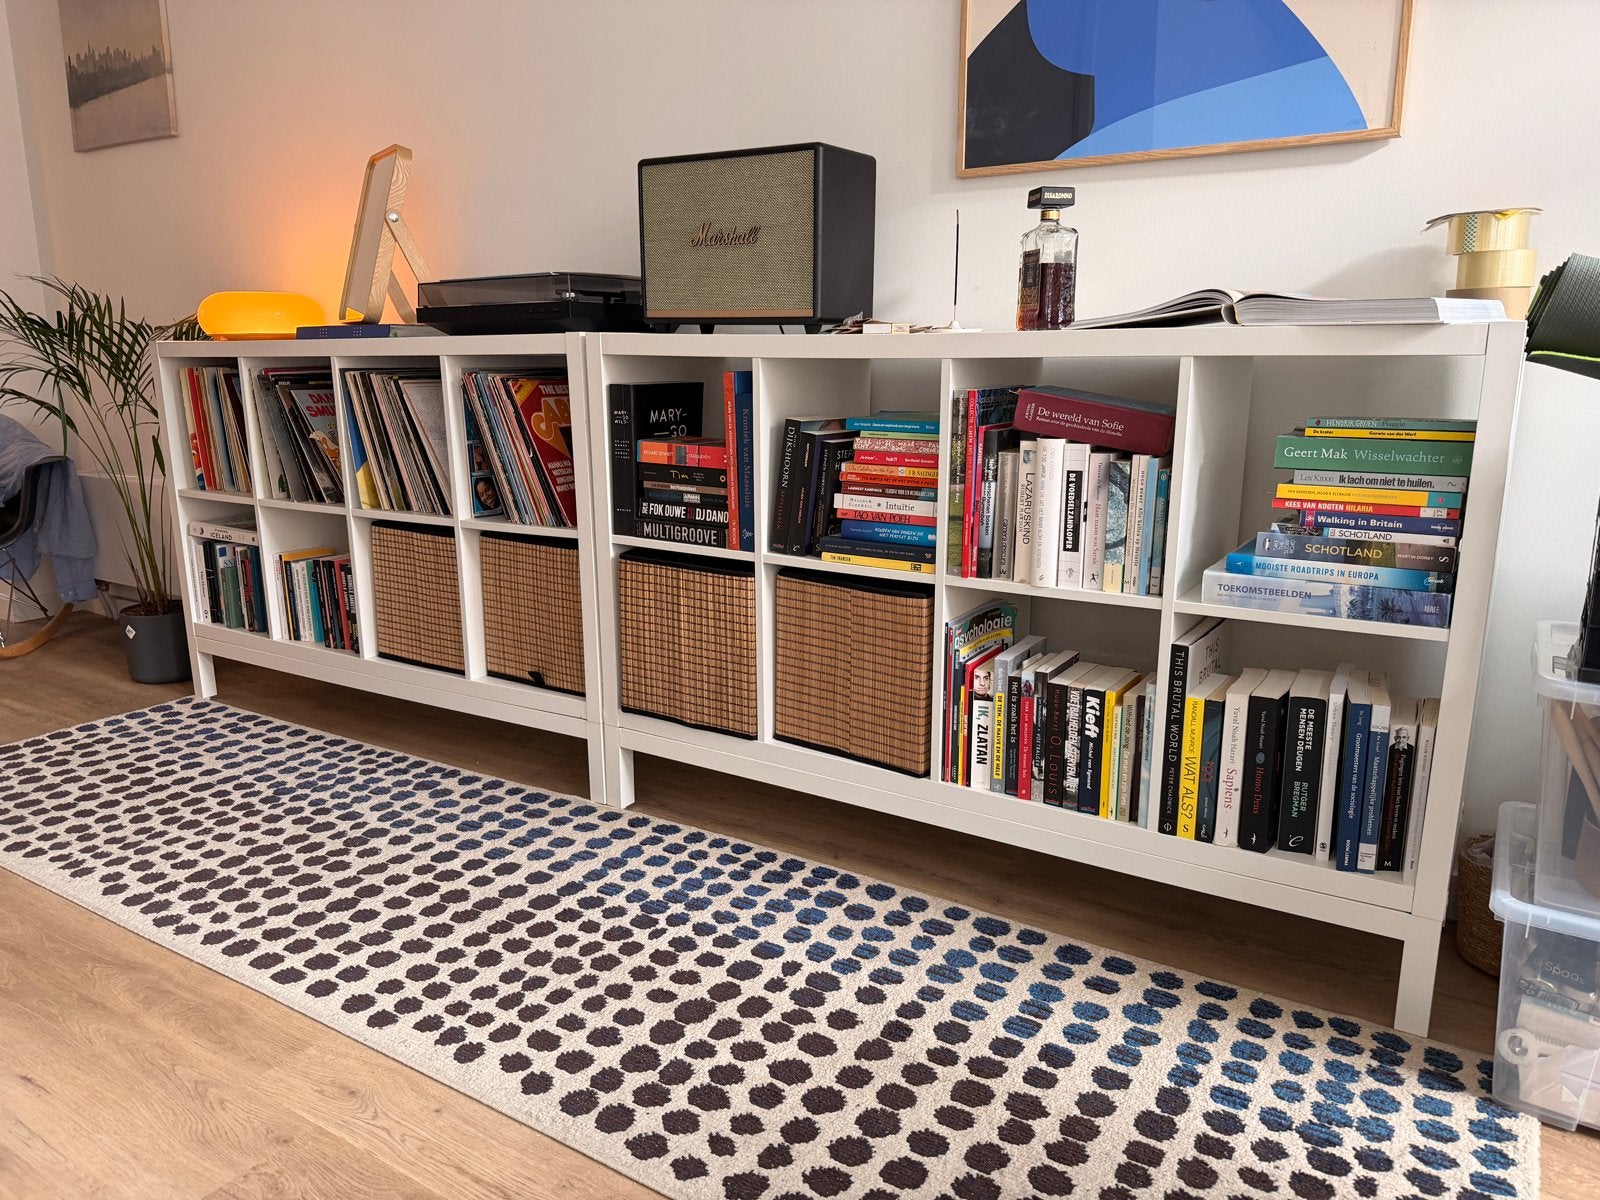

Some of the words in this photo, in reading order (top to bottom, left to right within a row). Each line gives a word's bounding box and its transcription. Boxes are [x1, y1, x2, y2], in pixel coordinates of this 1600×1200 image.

[691, 222, 761, 248] Marshall
[742, 409, 750, 442] Kroniek
[1037, 406, 1051, 417] De
[1052, 411, 1082, 423] wereld
[1083, 418, 1100, 427] van
[1101, 418, 1124, 431] Sofie
[781, 426, 796, 488] DIJKSHOORN
[1284, 446, 1318, 459] Geert
[1320, 446, 1348, 460] Mak
[1353, 449, 1446, 464] Wisselwachter
[743, 465, 751, 508] Maassluis
[820, 472, 828, 495] HAWKING
[1069, 473, 1076, 482] DE
[1300, 473, 1313, 481] Lex
[1313, 474, 1334, 483] Kroon
[1339, 474, 1347, 484] Ik
[1347, 474, 1364, 485] lach
[1366, 477, 1379, 486] om
[1379, 476, 1396, 487] niet
[1396, 477, 1406, 487] te
[1406, 477, 1435, 489] huilen.
[649, 503, 663, 515] FOK
[664, 504, 686, 519] OUWE
[695, 508, 705, 521] DJ
[706, 510, 728, 523] DANO
[854, 510, 869, 520] TAO
[872, 511, 887, 522] VAN
[890, 512, 911, 524] POEH
[1023, 472, 1036, 545] LAZARUSKIND
[1065, 483, 1076, 550] VOEDSELZANDLOPER
[1318, 503, 1344, 511] KOOTEN
[1345, 504, 1373, 513] HILARIA
[643, 522, 718, 545] MULTIGROOVE
[1317, 515, 1355, 526] Walking
[1370, 518, 1403, 529] Britain
[209, 532, 233, 541] ICELAND
[1338, 530, 1393, 541] SCHOTLAND
[1304, 543, 1383, 558] SCHOTLAND
[1255, 562, 1288, 572] MOOISTE
[1290, 565, 1335, 577] ROADTRIPS
[1337, 569, 1345, 577] IN
[1347, 570, 1379, 581] EUROPA
[1217, 583, 1312, 600] TOEKOMSTBEELDEN
[1206, 638, 1219, 661] THIS
[1174, 651, 1185, 676] THIS
[1198, 656, 1221, 685] BRUTAL
[997, 695, 1004, 703] DE
[1170, 679, 1183, 720] BRUTAL
[976, 705, 989, 721] IK,
[996, 719, 1004, 727] DE
[1010, 703, 1018, 722] zoals
[1068, 690, 1081, 744] VOETBALHELDEN
[1084, 695, 1101, 739] Kieft
[1125, 704, 1133, 726] Wilfried
[1190, 700, 1198, 728] RANDALL
[1232, 706, 1241, 725] Yuval
[1298, 707, 1307, 739] MENSEN
[1307, 708, 1315, 719] DE
[976, 723, 989, 765] ZLATAN
[995, 727, 1003, 745] HALVE
[1049, 735, 1062, 749] O,
[1122, 735, 1130, 749] Jong
[1168, 724, 1180, 762] WORLD
[1231, 725, 1240, 743] Noah
[1305, 720, 1314, 750] MEESTE
[995, 746, 1002, 754] EN
[995, 754, 1002, 762] DE
[1066, 745, 1079, 777] STERVEN
[1123, 750, 1130, 758] De
[1229, 744, 1238, 764] Harari
[1294, 740, 1305, 772] DEUGEN
[1352, 733, 1363, 773] Grootmeesters
[1048, 754, 1060, 795] Louis
[1122, 773, 1128, 781] en
[1183, 755, 1197, 785] WAT
[1398, 754, 1407, 777] Pogingen
[1120, 781, 1128, 793] zijn
[1222, 768, 1237, 810] Sapiens
[1254, 766, 1265, 792] Homo
[1368, 756, 1381, 805] Maatschappelijke
[1166, 785, 1174, 815] CHADWICK
[1180, 786, 1195, 819] ALS?
[1252, 794, 1263, 815] Deus
[1291, 781, 1301, 818] BREGMAN
[1299, 782, 1309, 812] RUTGER
[1348, 792, 1356, 819] sociologie
[1366, 805, 1376, 836] problemen
[1393, 804, 1401, 818] leven
